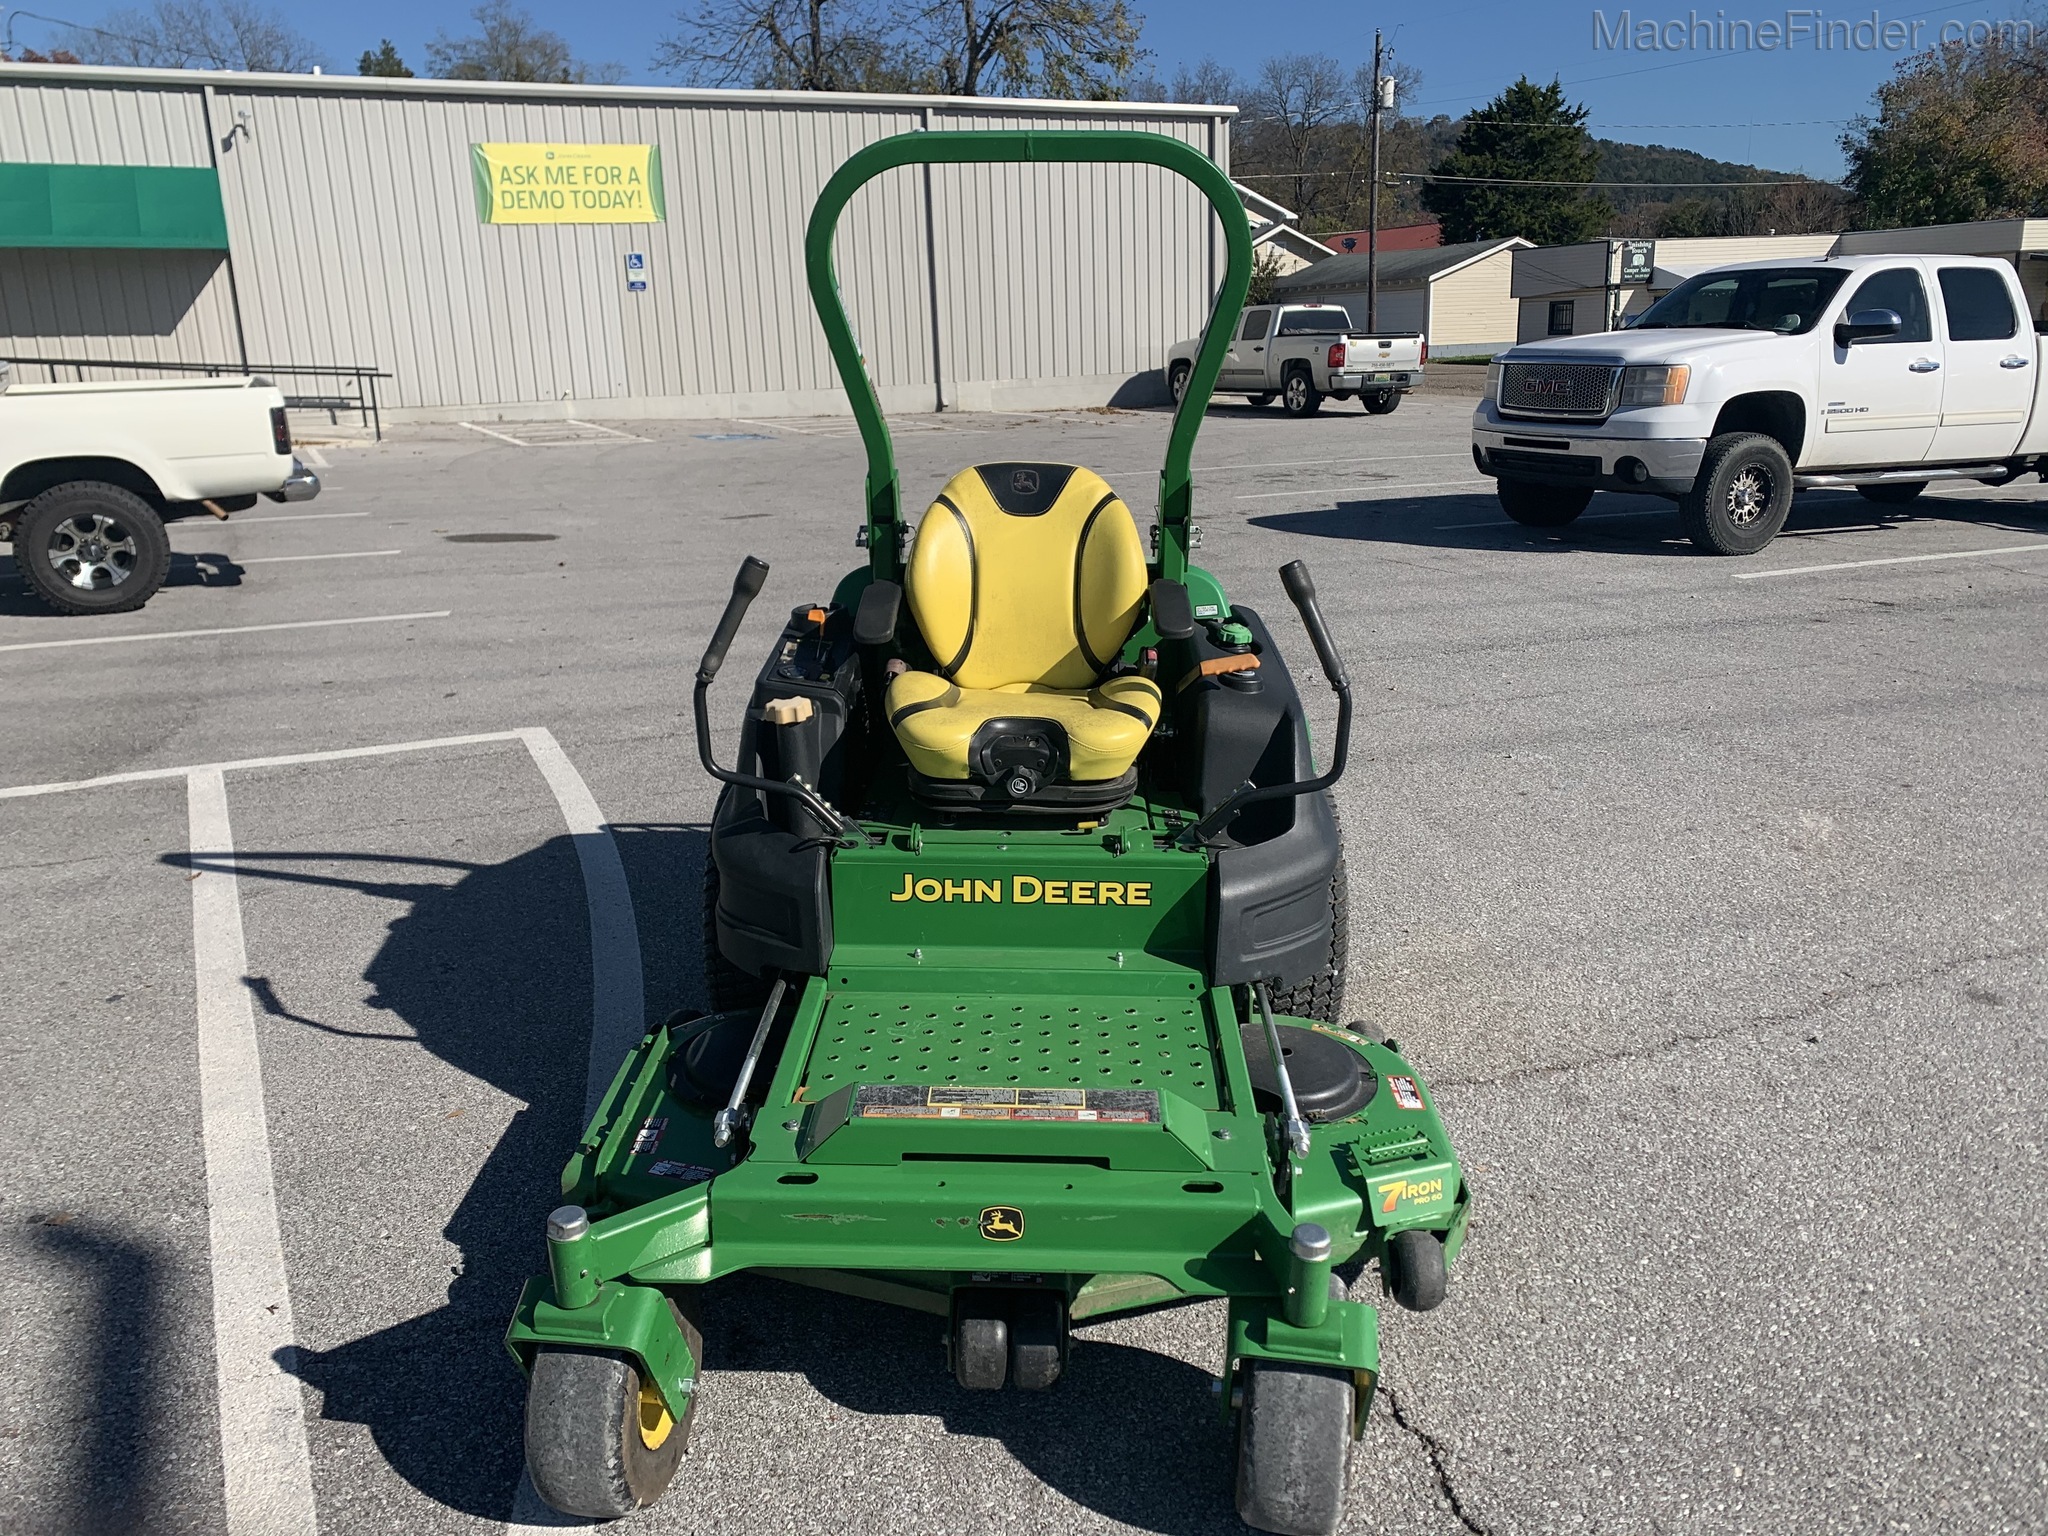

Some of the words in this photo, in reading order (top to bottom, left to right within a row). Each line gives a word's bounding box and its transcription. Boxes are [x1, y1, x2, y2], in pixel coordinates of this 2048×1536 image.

[499, 165, 540, 185] ASK
[545, 165, 579, 185] ME
[583, 166, 623, 185] FOR
[627, 166, 641, 185] A
[502, 190, 565, 209] DEMO
[570, 190, 643, 208] TODAY!
[1523, 378, 1571, 395] GMC
[1854, 406, 1869, 414] HD
[890, 872, 1003, 904] JOHN
[1011, 874, 1153, 906] DEERE
[1414, 1196, 1430, 1206] PRO
[1431, 1192, 1443, 1203] 60
